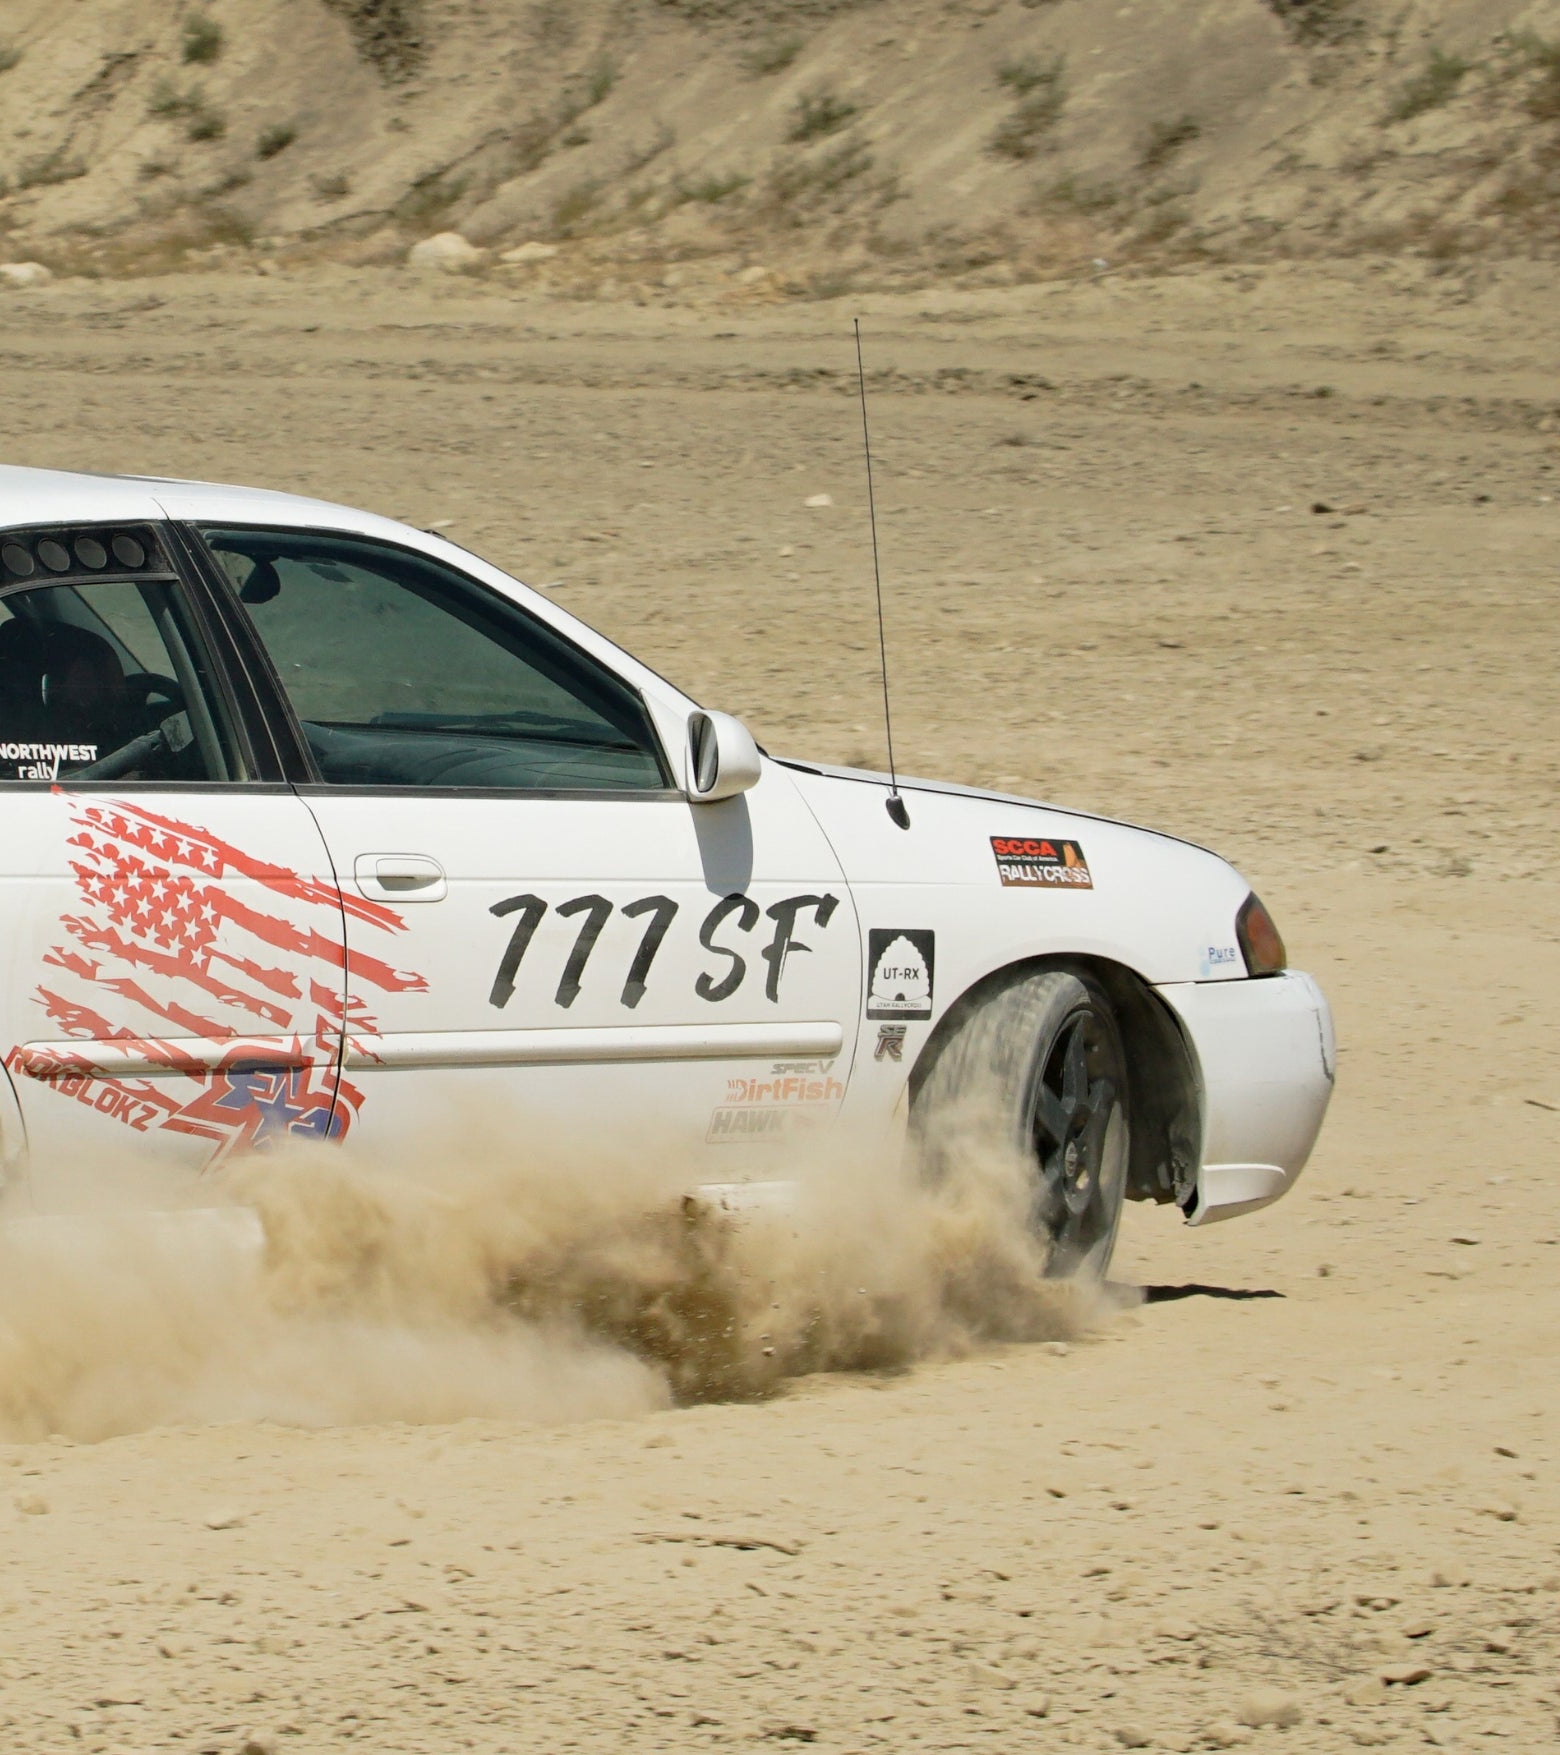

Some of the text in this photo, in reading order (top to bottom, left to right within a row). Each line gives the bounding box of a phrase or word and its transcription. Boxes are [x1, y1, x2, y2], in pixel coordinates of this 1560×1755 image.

[18, 761, 59, 780] rally
[993, 839, 1057, 857] SCCA
[1000, 865, 1091, 884] RALLYCROSS
[695, 892, 840, 1003] SF
[883, 967, 920, 980] UT-RX
[726, 1077, 845, 1102] DirtFish
[711, 1110, 789, 1135] HAWK
